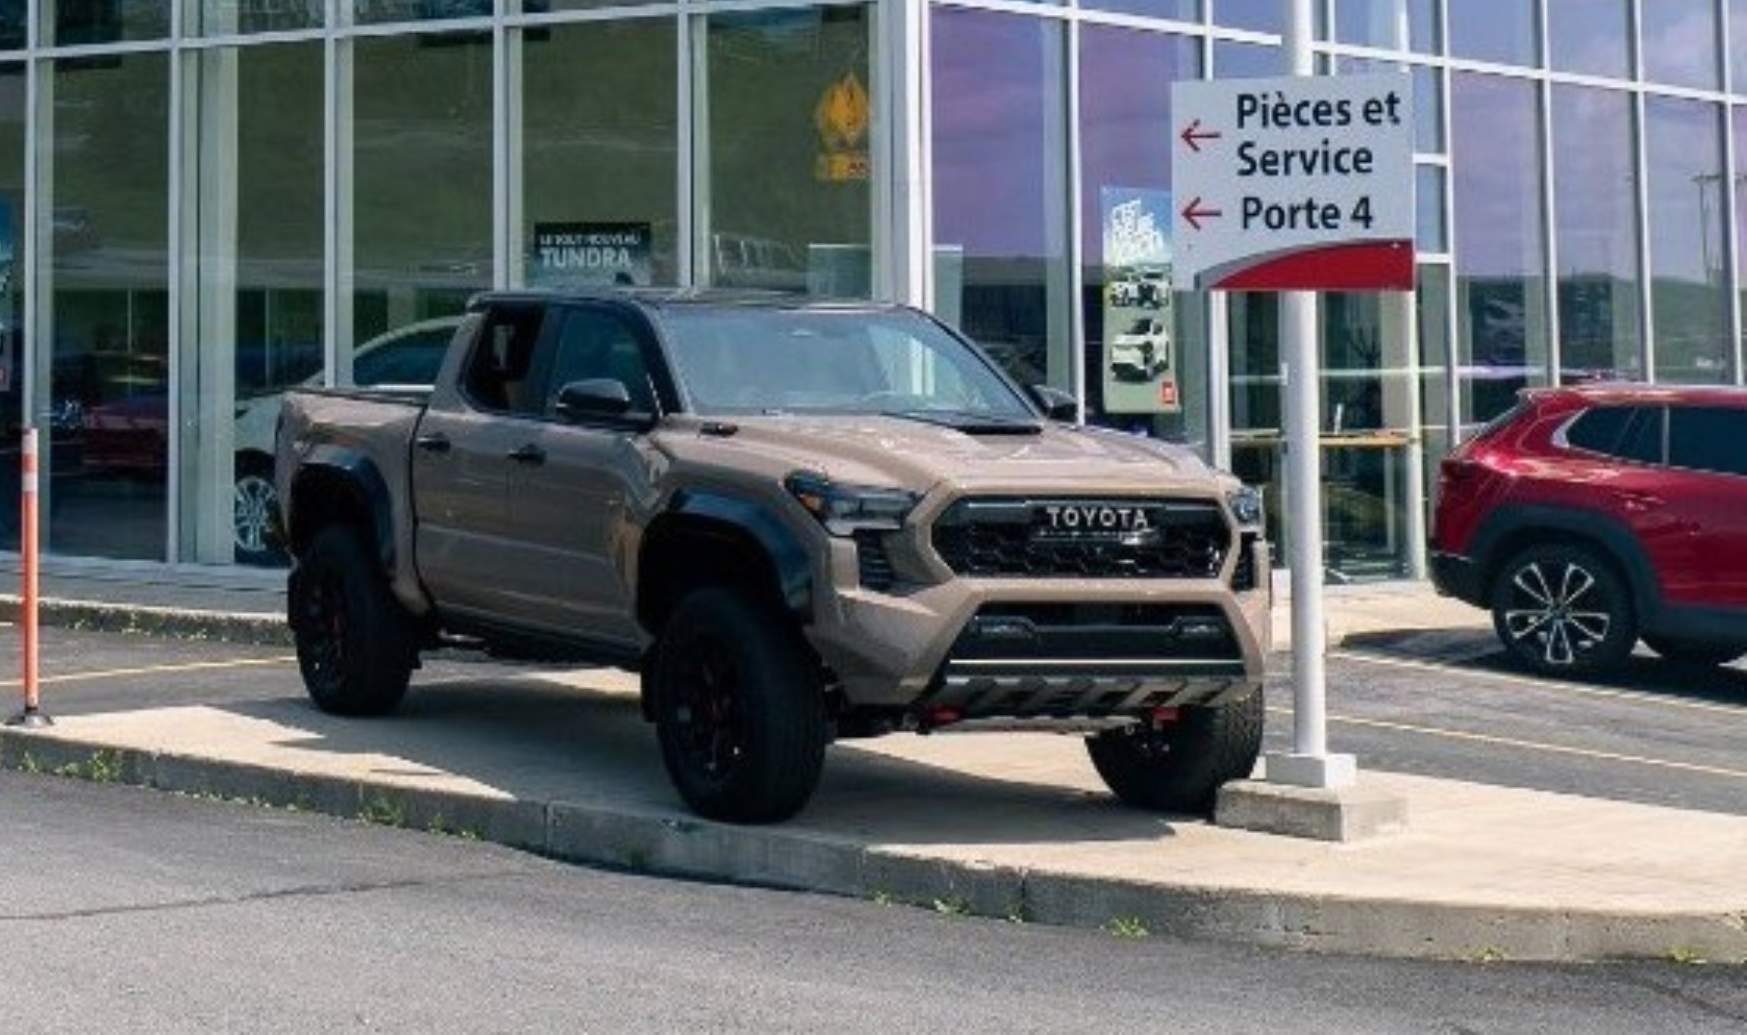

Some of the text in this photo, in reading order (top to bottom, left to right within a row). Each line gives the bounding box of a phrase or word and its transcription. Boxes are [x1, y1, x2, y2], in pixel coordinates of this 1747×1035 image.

[1236, 91, 1401, 129] Pièces et
[1237, 138, 1373, 177] Service
[1242, 196, 1373, 230] Porte 4
[540, 247, 633, 268] TUNDRA
[1046, 507, 1148, 529] TOYOTA
